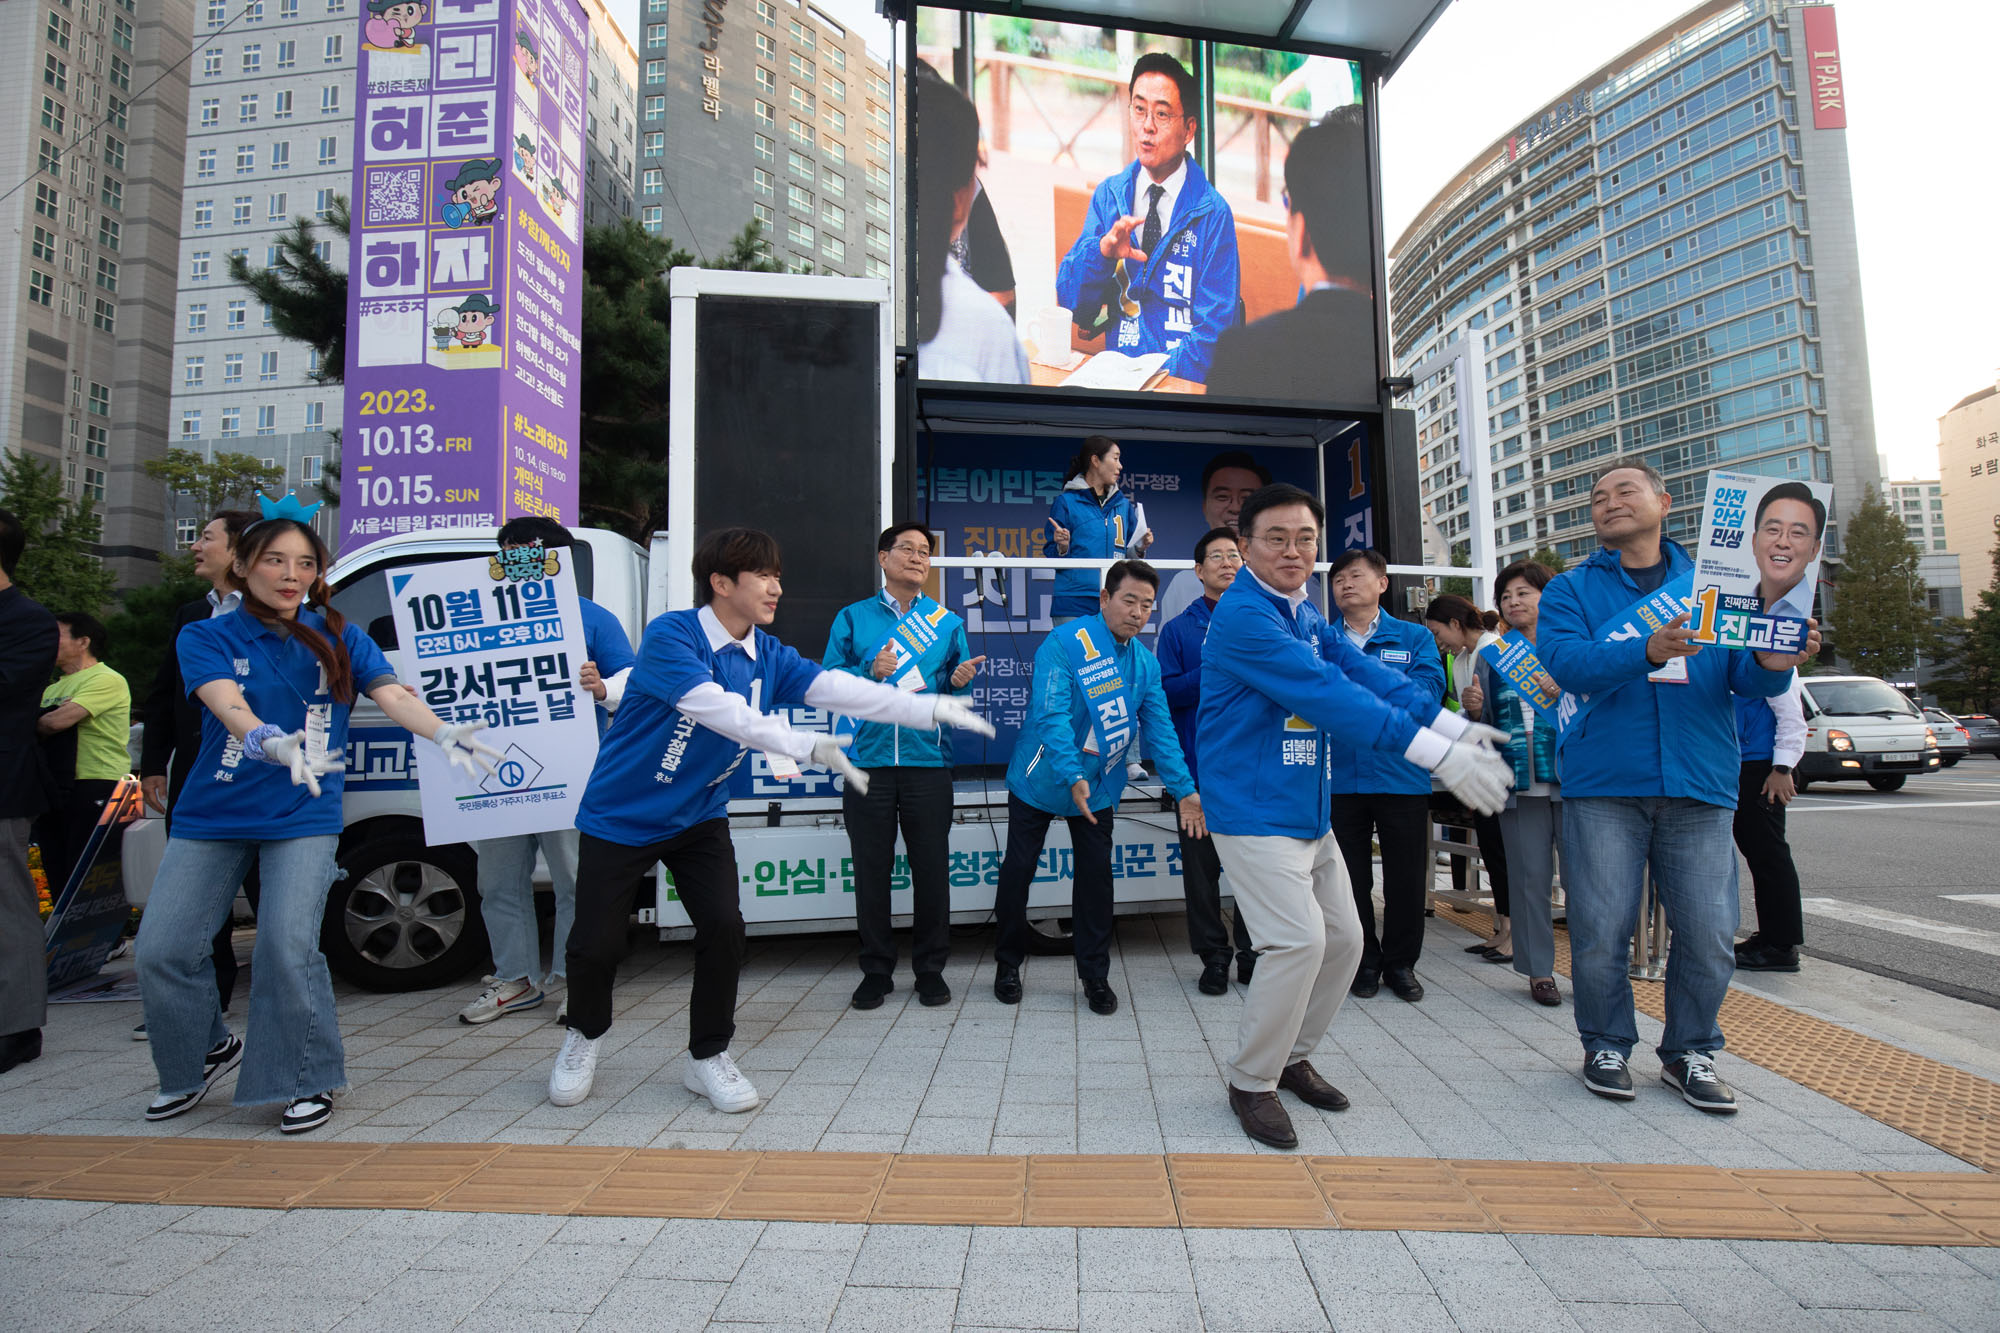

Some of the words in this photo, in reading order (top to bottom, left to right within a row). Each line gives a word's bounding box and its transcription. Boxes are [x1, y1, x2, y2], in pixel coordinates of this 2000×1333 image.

[368, 78, 430, 94] #허준축제
[1813, 49, 1842, 111] I'PARK
[518, 208, 571, 273] #함께하자
[516, 290, 539, 320] 어린이
[516, 314, 539, 343] 잔디밭
[555, 345, 568, 366] 요가
[359, 389, 436, 416] 2023.
[359, 424, 443, 456] 10.13.
[445, 437, 472, 453] FRI
[513, 412, 568, 460] #노래하자
[514, 466, 543, 496] 개막식
[1118, 473, 1181, 491] 서구청장
[1347, 437, 1366, 501] 1
[357, 475, 441, 507] 10.15.
[445, 488, 480, 503] SUN
[1712, 487, 1747, 509] 안전
[513, 489, 561, 524] 허준콘서트
[1711, 507, 1746, 528] 안심
[349, 515, 427, 534] 서울식물원
[430, 513, 495, 529] 잔디마당
[1113, 514, 1125, 548] 1
[1710, 528, 1744, 549] 민생
[407, 588, 484, 632] 10월
[492, 579, 559, 621] 11일
[925, 604, 949, 629] 1
[1724, 595, 1760, 611] 진짜일꾼
[1692, 585, 1719, 644] 1
[1719, 614, 1802, 652] 진교훈
[417, 635, 452, 656] 오전
[453, 631, 480, 650] 6시
[499, 625, 533, 645] 오후
[534, 620, 563, 641] 8시
[1074, 627, 1101, 662] 1
[420, 652, 572, 706] 강서구민
[546, 691, 575, 722] 날
[1282, 739, 1317, 753] 더불어
[1283, 752, 1317, 766] 민주당
[213, 769, 234, 782] 후보
[653, 771, 673, 784] 후보
[499, 795, 523, 807] 거주지
[525, 793, 541, 804] 지정
[542, 791, 567, 801] 투표소
